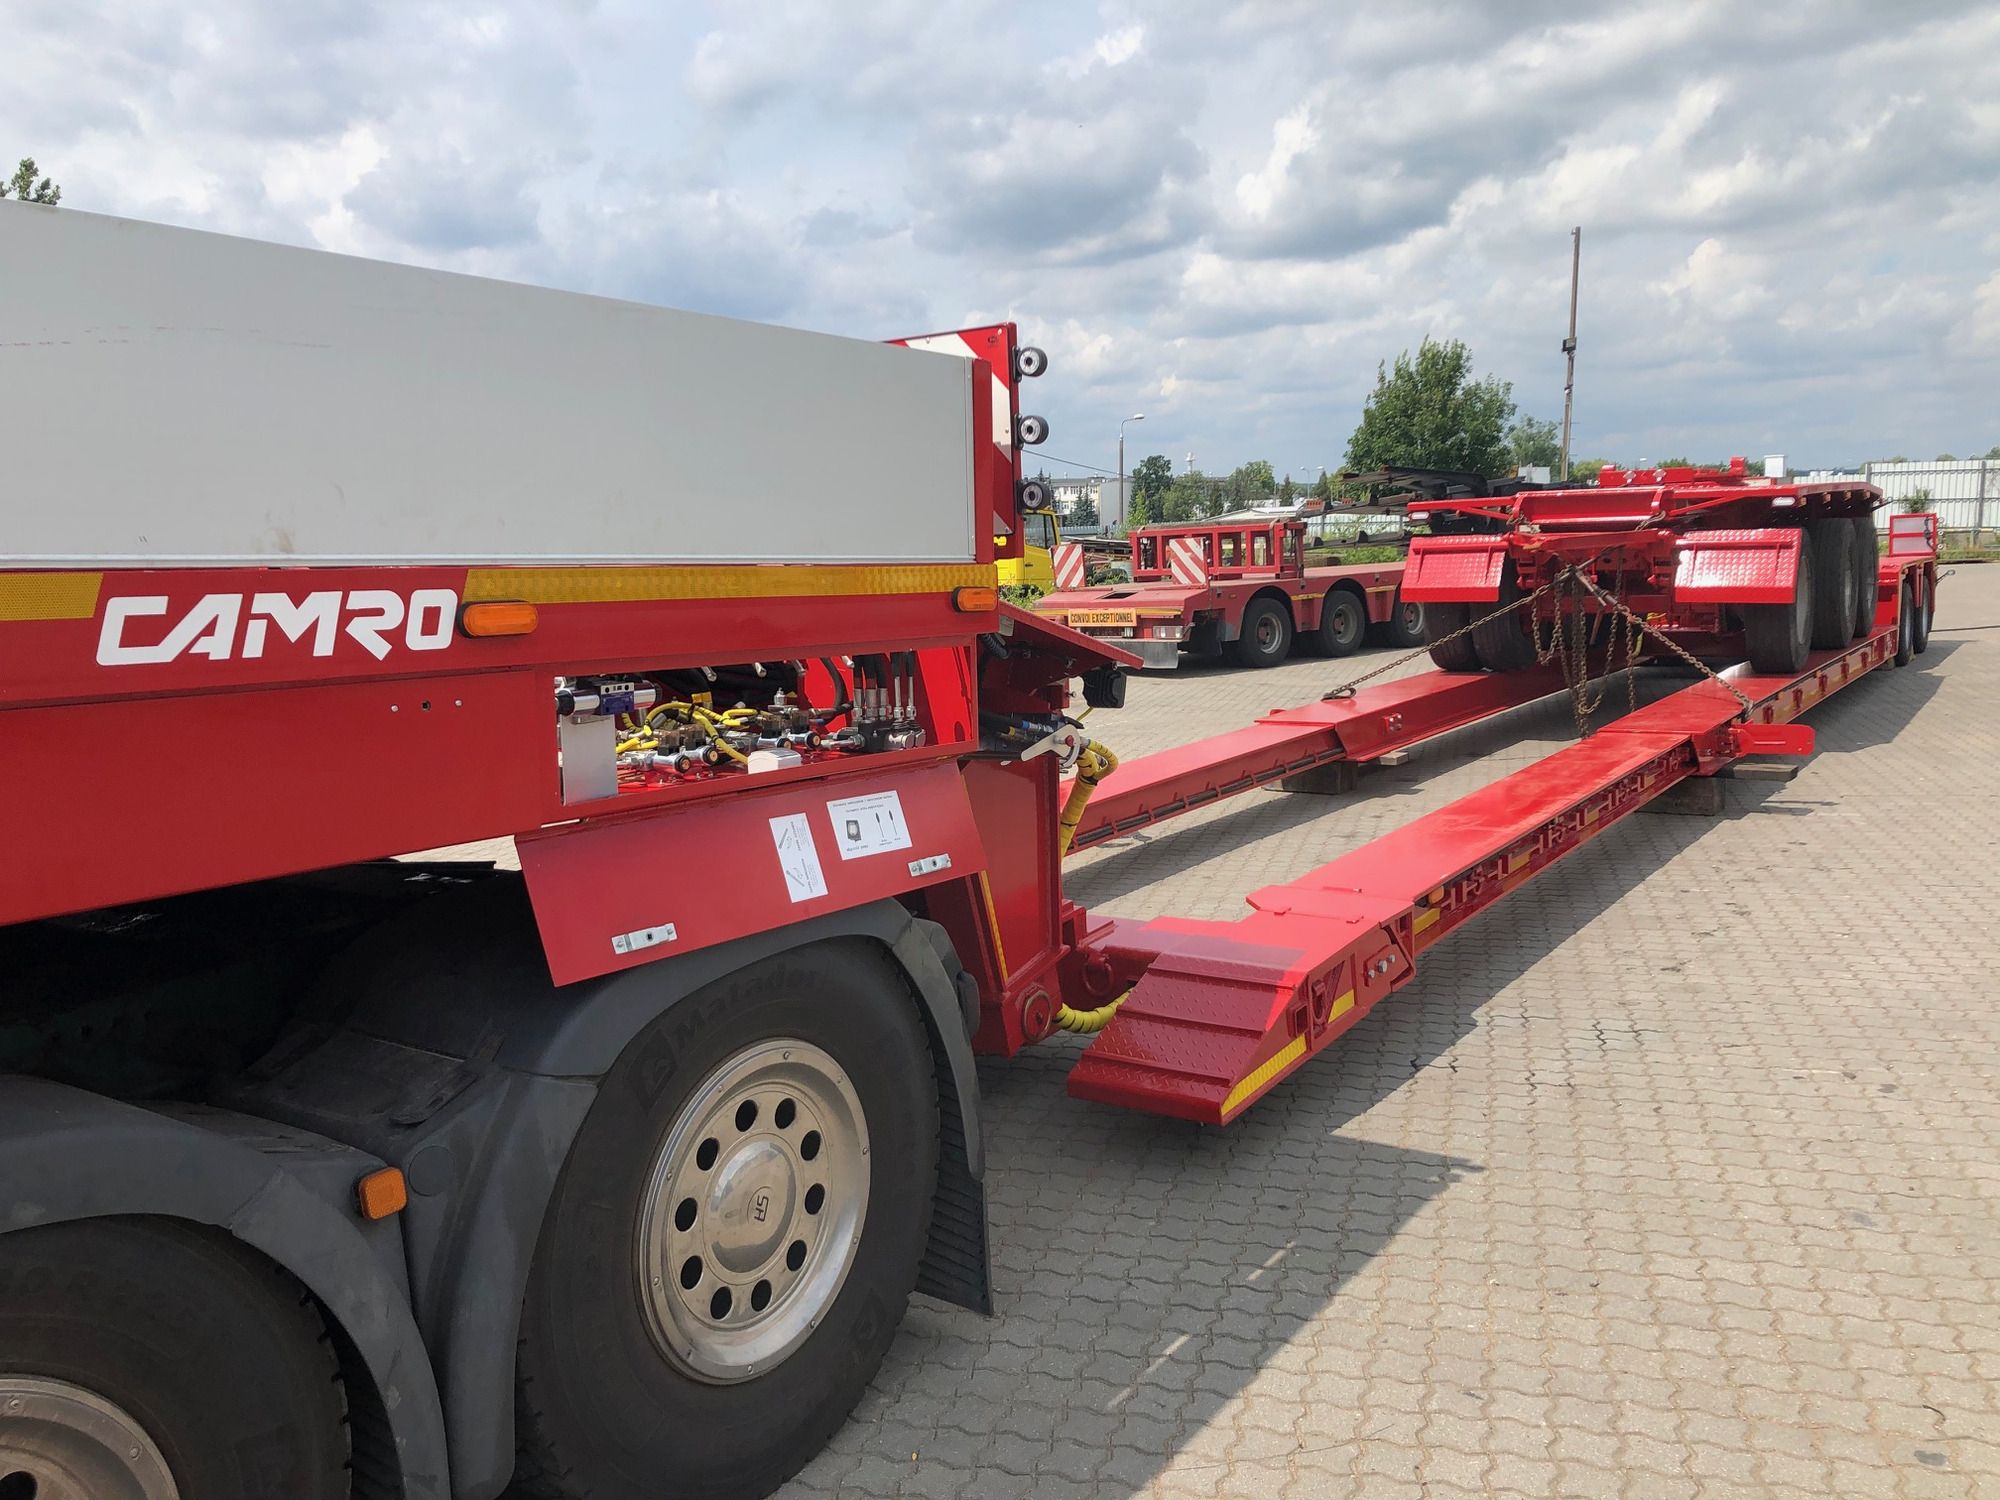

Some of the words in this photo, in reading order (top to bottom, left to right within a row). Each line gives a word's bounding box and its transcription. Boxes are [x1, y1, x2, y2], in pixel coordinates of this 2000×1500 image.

[96, 589, 457, 666] CAMRO
[1071, 613, 1091, 623] CONVOI
[1092, 612, 1133, 623] EXCEPTIONNEL
